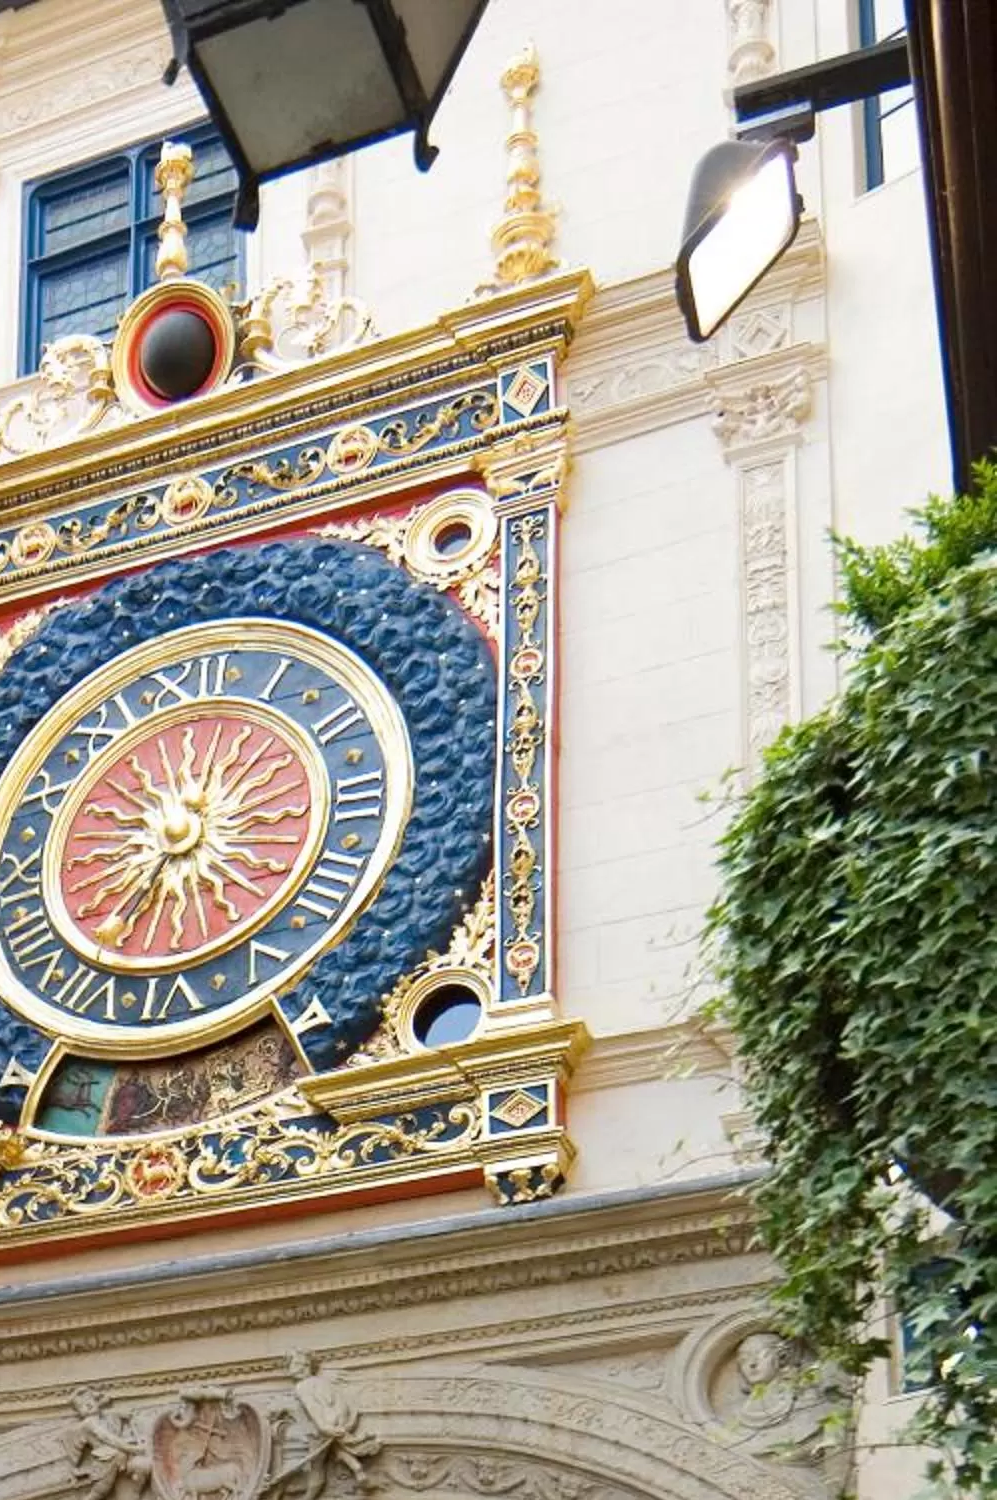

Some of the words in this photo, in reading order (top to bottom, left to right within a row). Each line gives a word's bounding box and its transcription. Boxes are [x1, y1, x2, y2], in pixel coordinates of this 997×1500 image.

[152, 653, 230, 705] XII
[257, 658, 292, 702] I
[71, 693, 137, 759] XI
[311, 703, 364, 745] II
[24, 768, 76, 818] X
[334, 770, 385, 822] III
[294, 850, 364, 921] IIII
[246, 940, 291, 985] V
